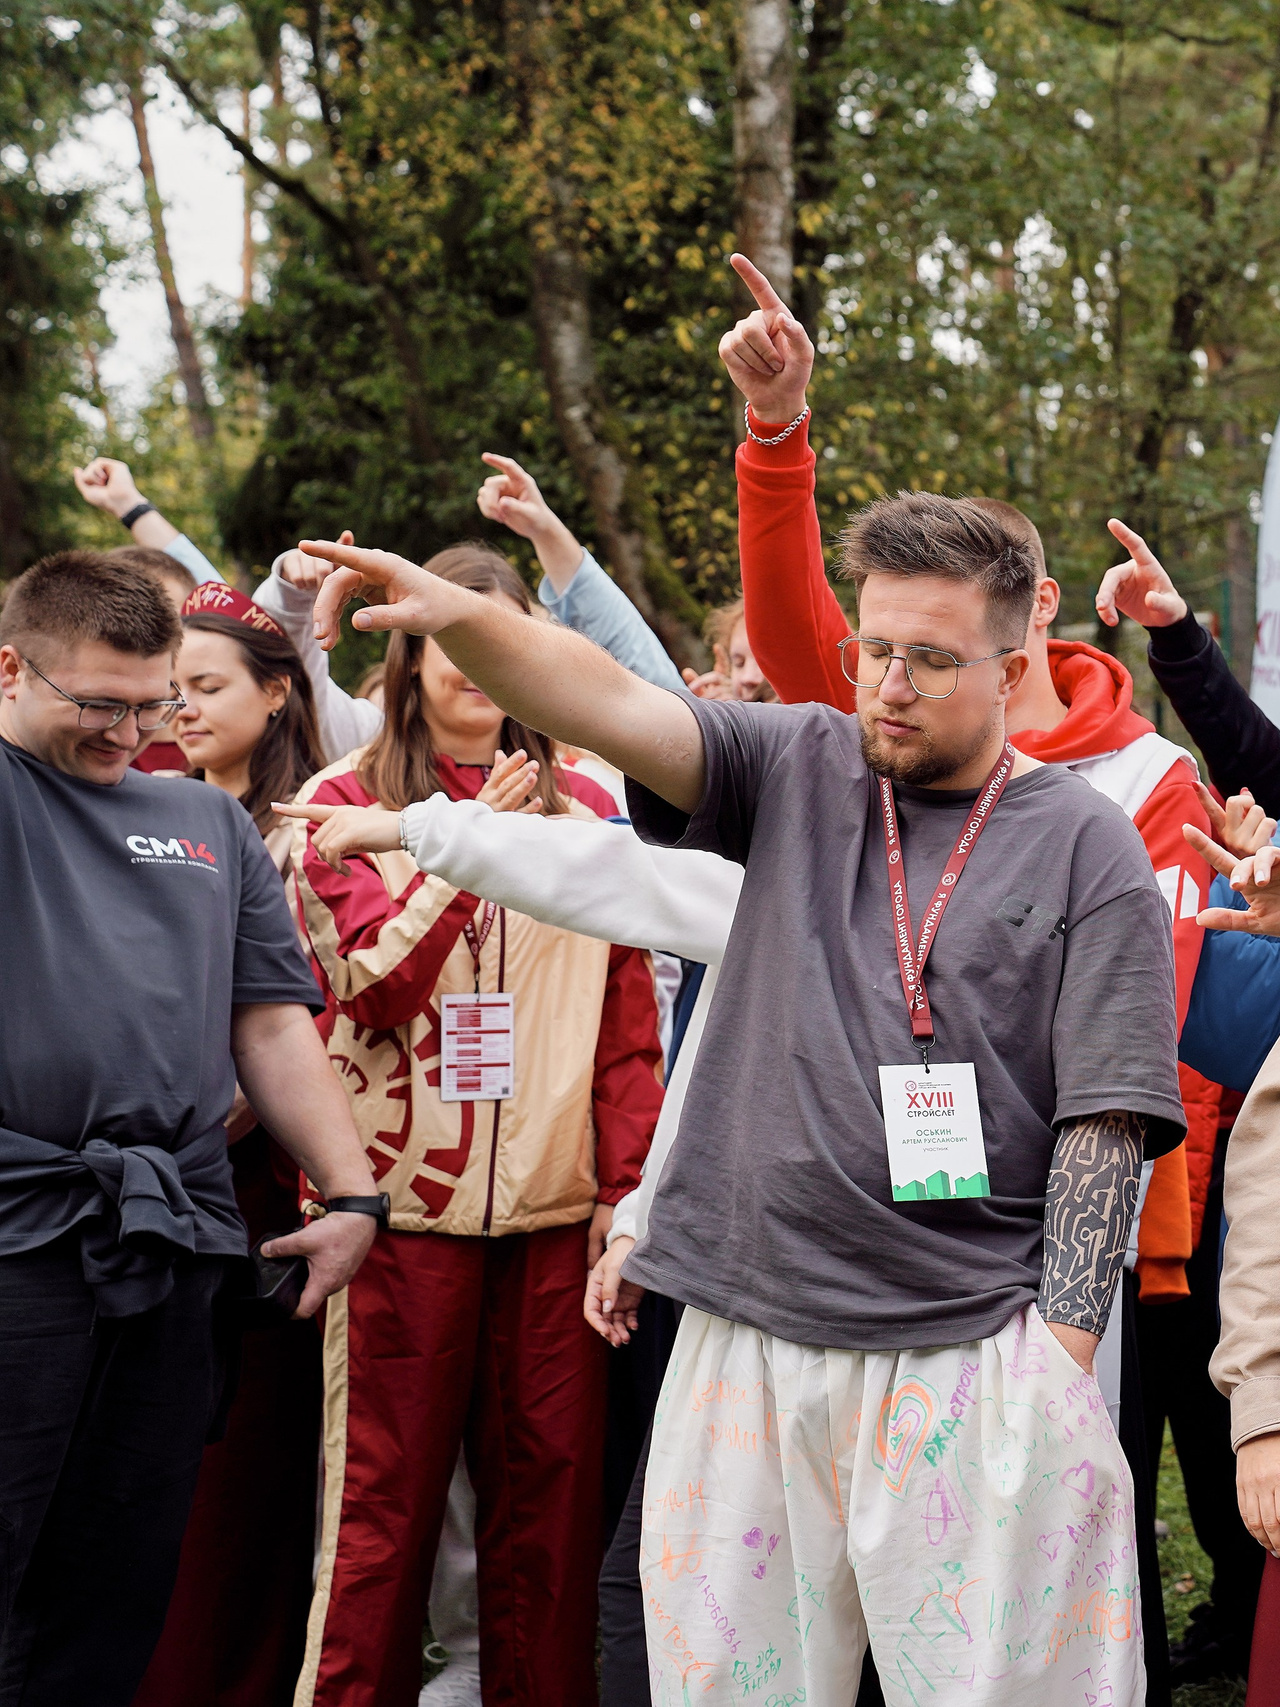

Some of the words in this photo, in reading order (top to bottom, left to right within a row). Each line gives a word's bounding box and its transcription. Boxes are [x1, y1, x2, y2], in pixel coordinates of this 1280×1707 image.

[1003, 758, 1011, 766] Я
[882, 782, 896, 837] ФУНДАМЕНТ
[975, 766, 1008, 817] ФУНДАМЕНТ
[956, 817, 982, 855] ГОРОДА
[893, 880, 905, 921] ГОРОДА
[917, 901, 943, 961] ФУНДАМЕНТ
[898, 922, 916, 983] ФУНДАМЕНТ
[906, 1091, 954, 1109] XVIII
[907, 1109, 955, 1118] СТРОЙСЛЁТ
[916, 1128, 952, 1137] ОСЬКИН
